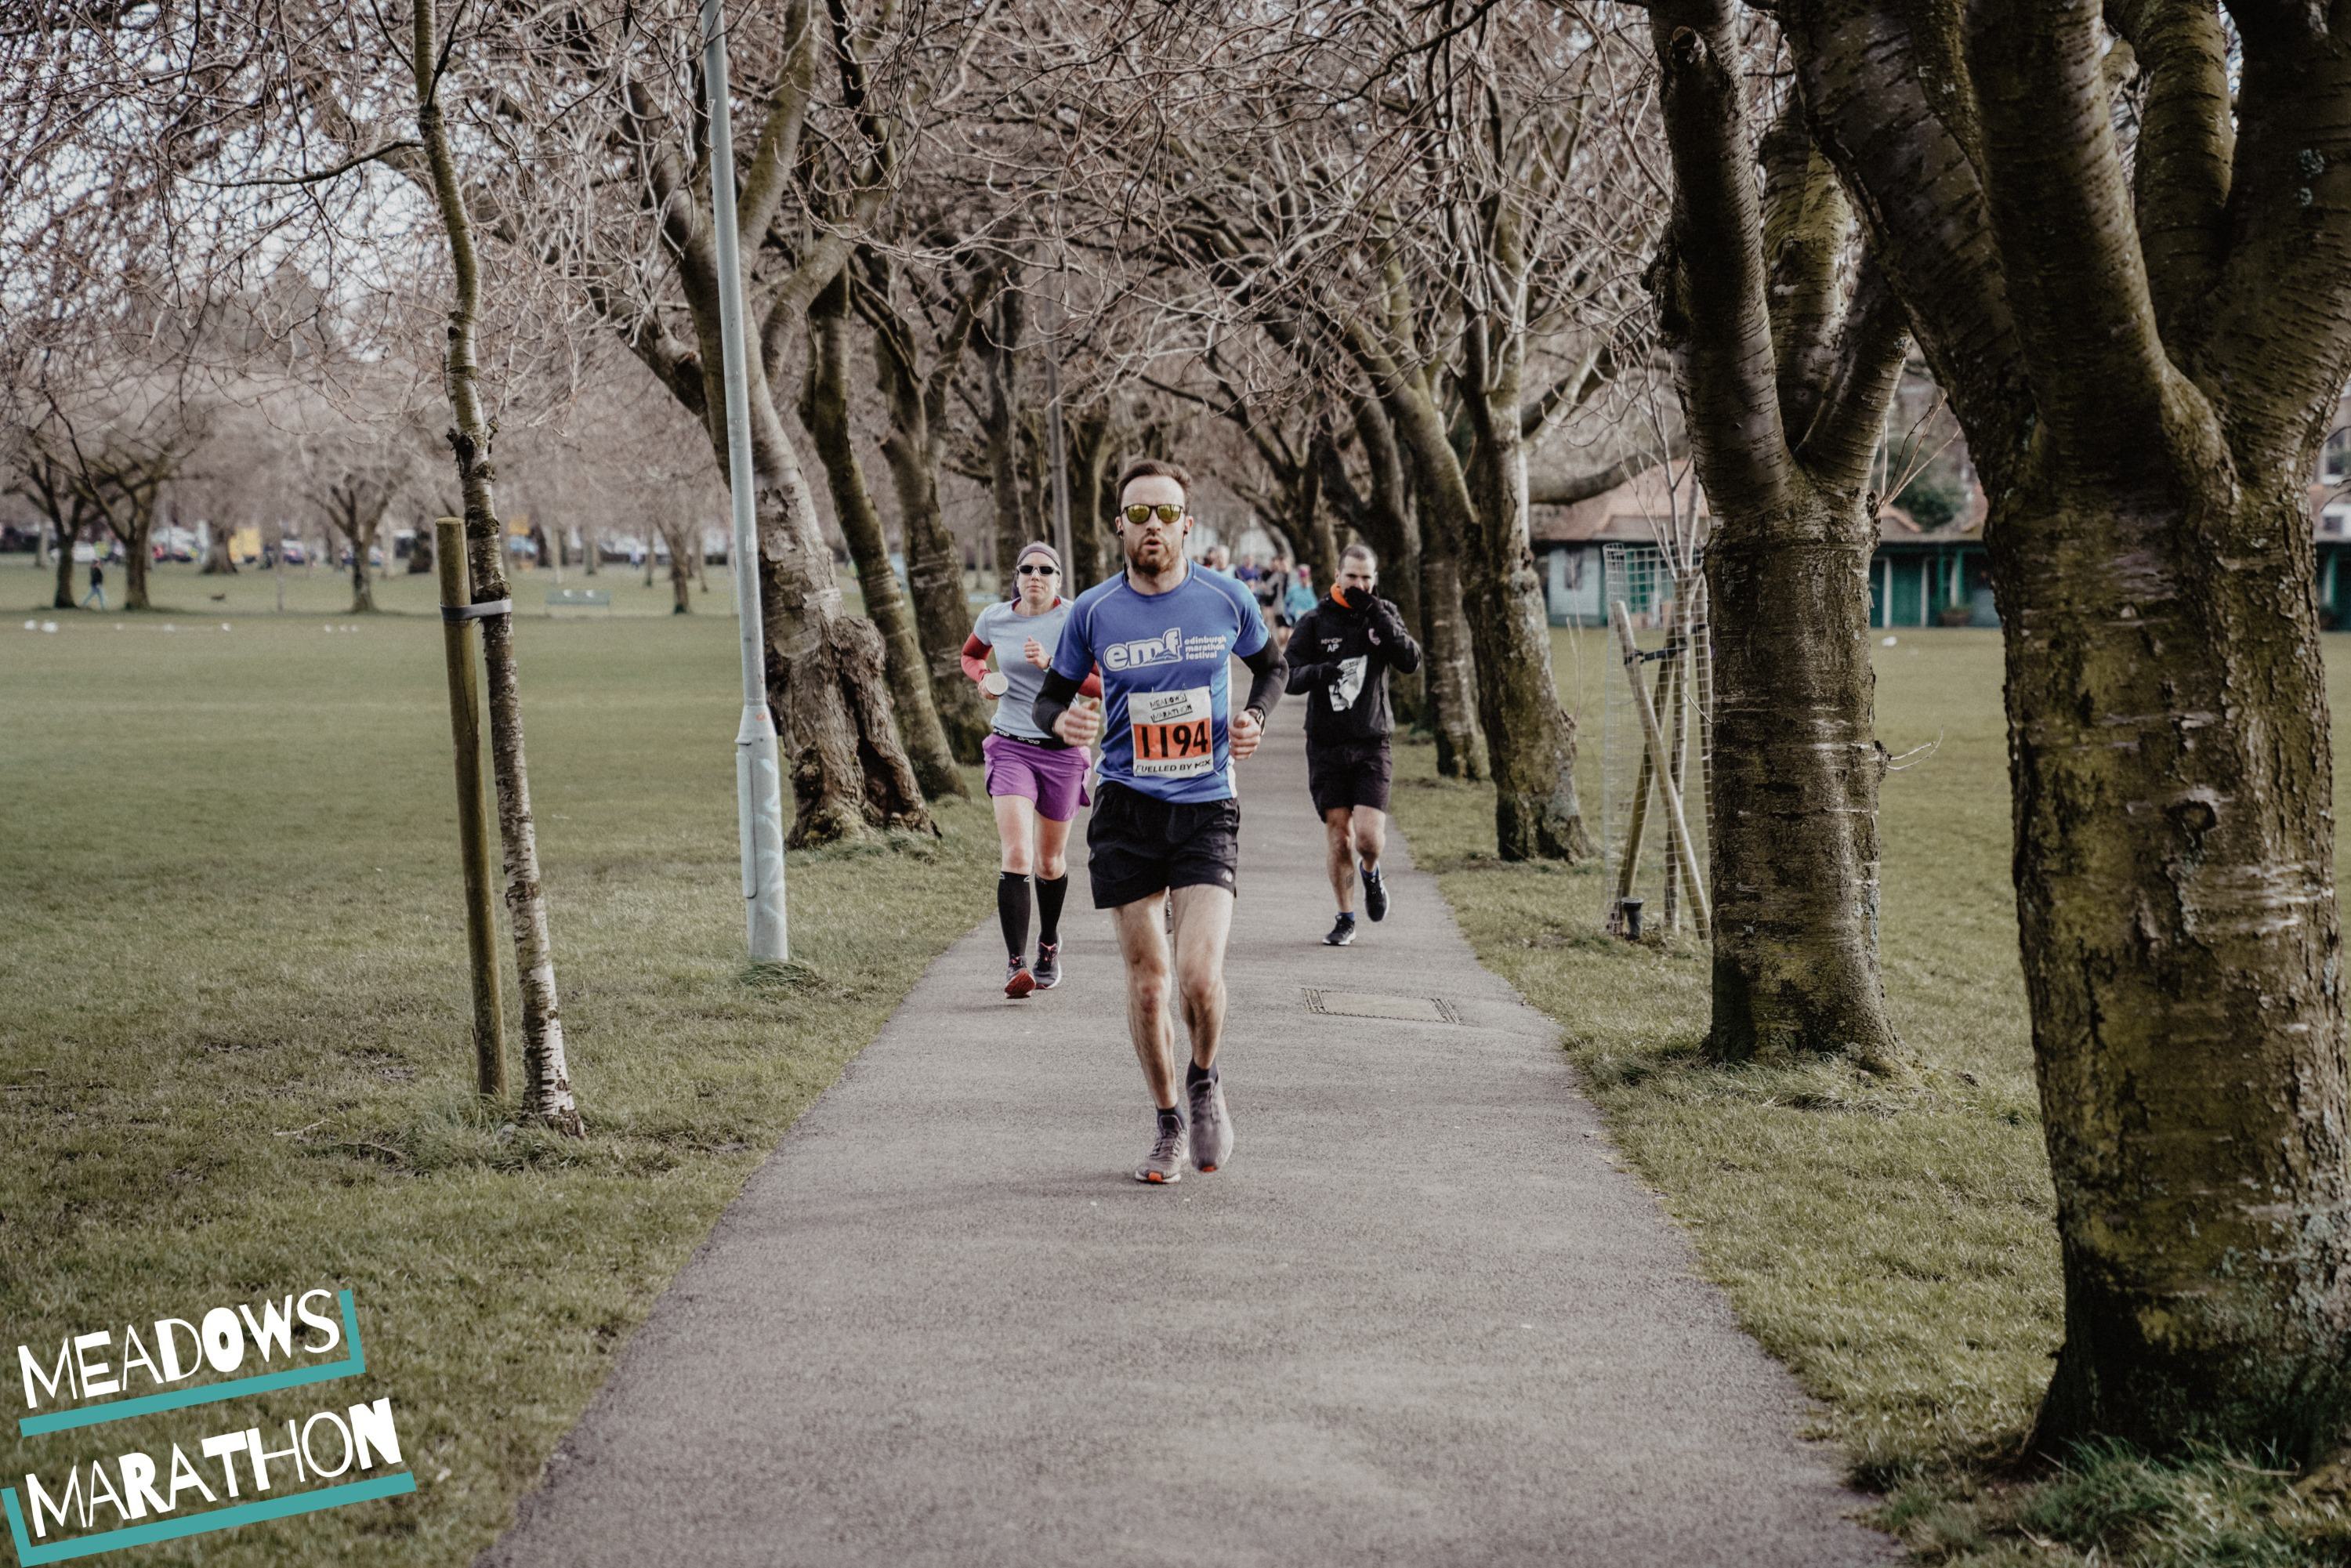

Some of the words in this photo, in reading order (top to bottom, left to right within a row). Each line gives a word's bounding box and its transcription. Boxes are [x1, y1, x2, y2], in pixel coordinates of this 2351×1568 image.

[1184, 634, 1226, 645] edinburgh
[1103, 627, 1183, 672] emf
[1185, 643, 1226, 653] marathon
[1327, 643, 1339, 653] AP
[1185, 650, 1218, 660] festival
[1141, 721, 1208, 758] 1194
[1136, 764, 1176, 773] FUELLED
